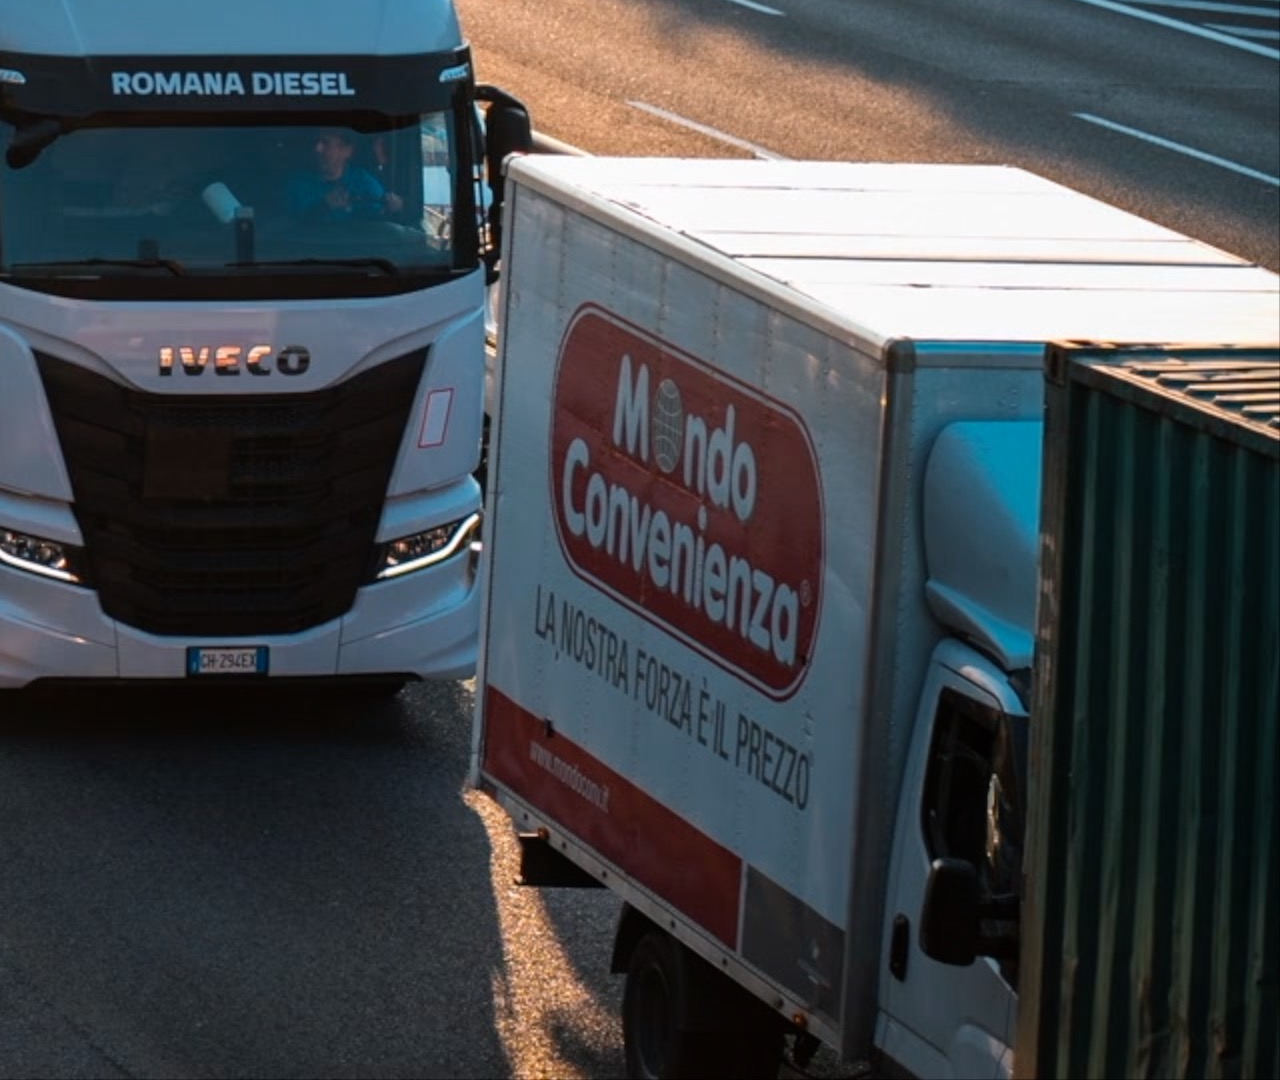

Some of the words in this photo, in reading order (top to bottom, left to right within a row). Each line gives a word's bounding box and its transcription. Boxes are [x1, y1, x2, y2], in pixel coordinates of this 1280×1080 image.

[111, 72, 245, 96] ROMANA
[252, 72, 355, 96] DIESEL
[159, 344, 311, 377] IVECO
[563, 437, 800, 666] Convenienza
[535, 584, 556, 646] LA
[561, 599, 630, 695] NOSTRA
[635, 648, 693, 737] FORZA
[697, 676, 711, 746] È
[714, 698, 729, 761] IL
[736, 713, 809, 811] PREZZO
